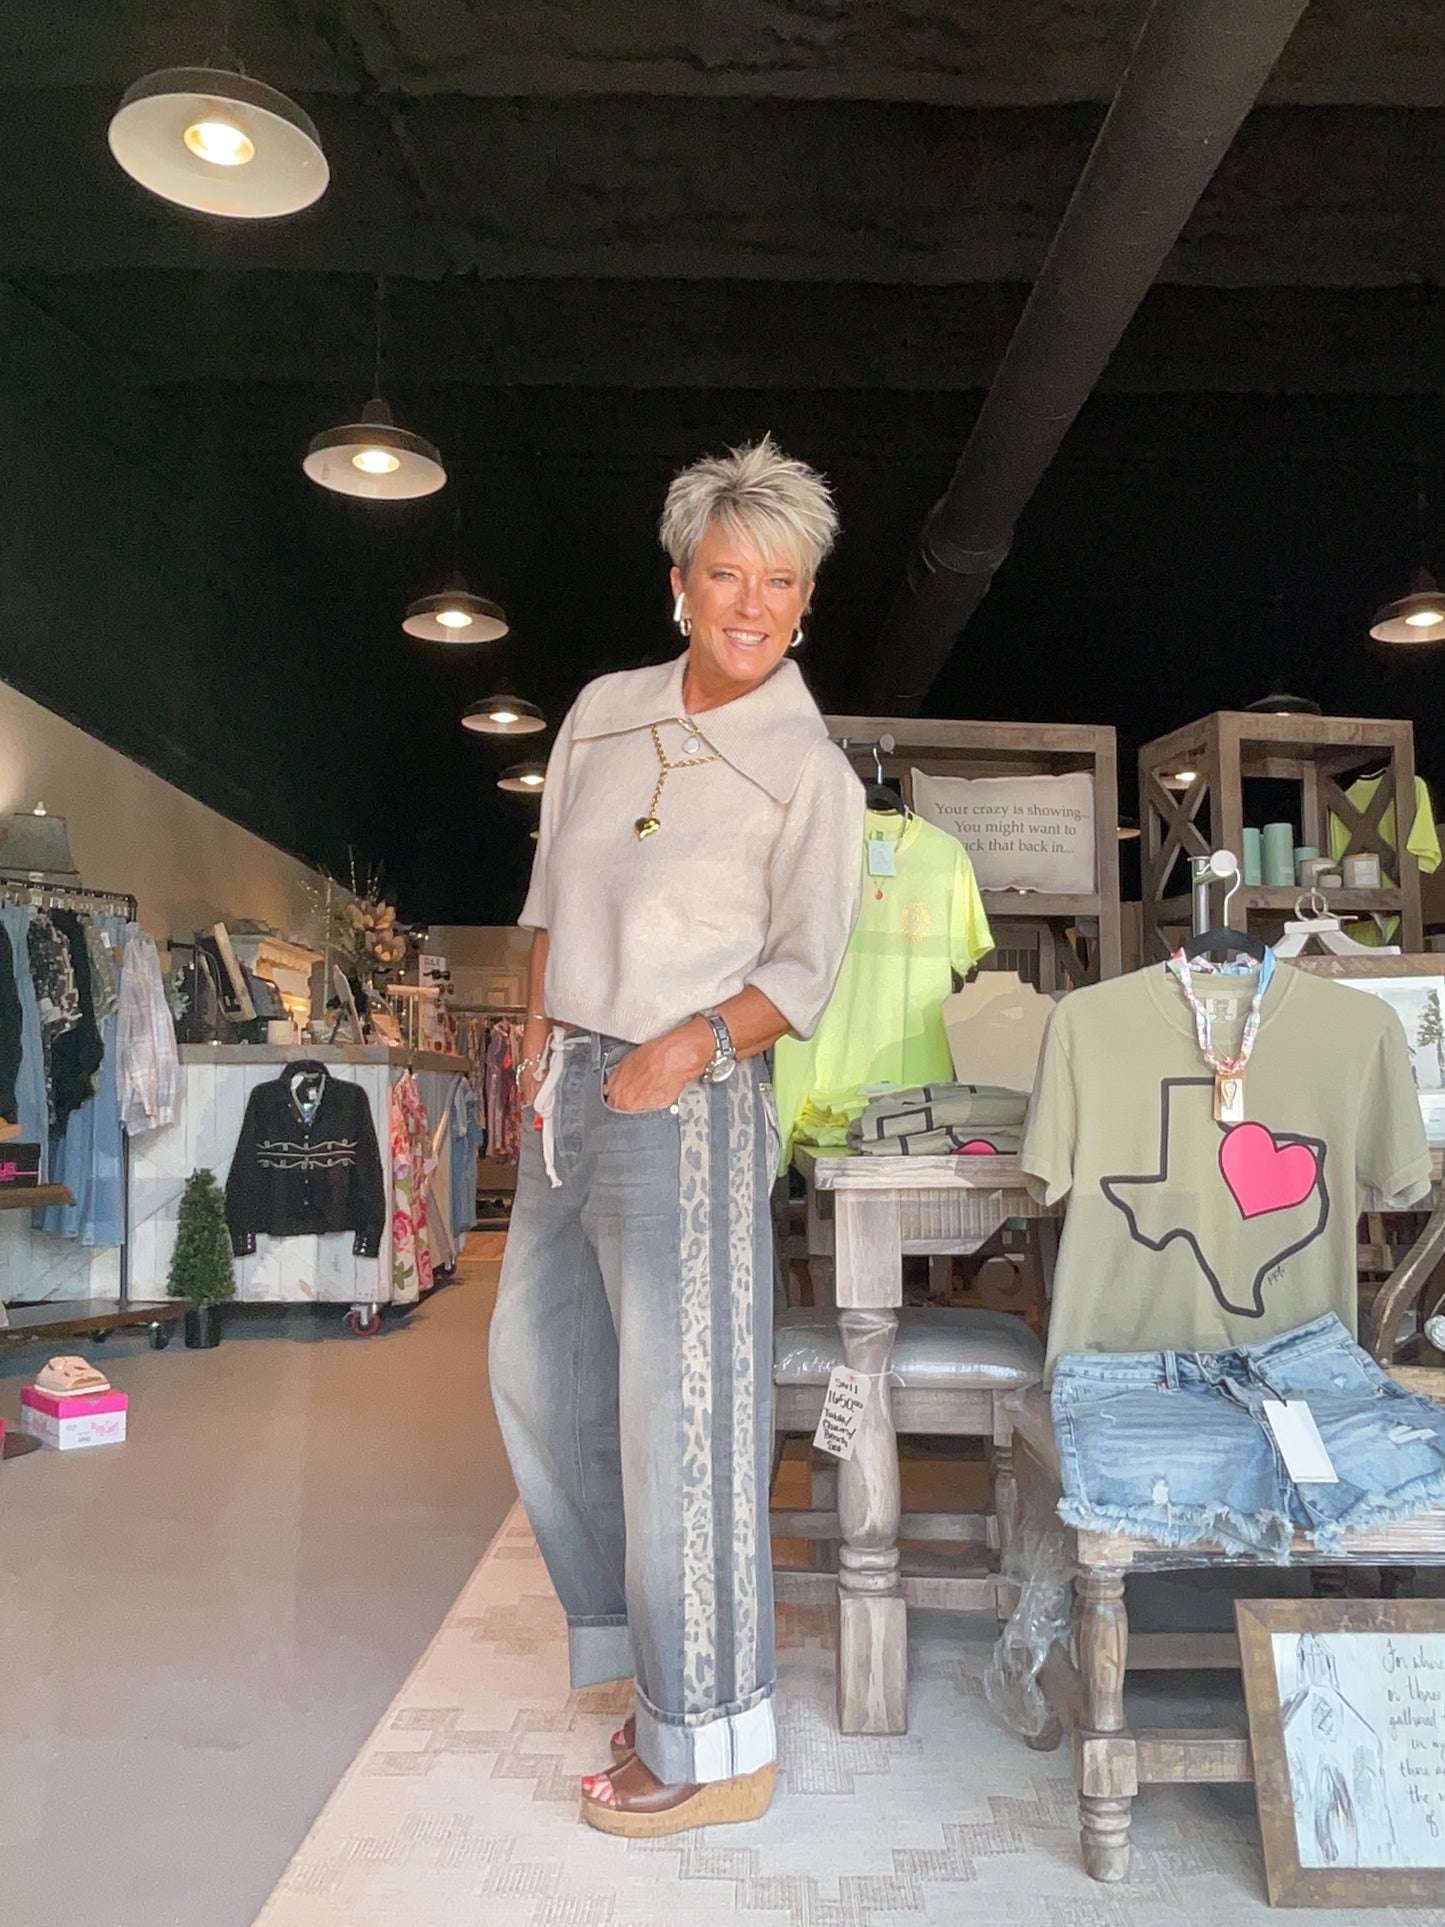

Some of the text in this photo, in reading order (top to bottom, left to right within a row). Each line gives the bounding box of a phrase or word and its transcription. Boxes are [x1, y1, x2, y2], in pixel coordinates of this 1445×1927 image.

[935, 802, 969, 815] Your
[972, 804, 1009, 819] crazy
[1013, 803, 1024, 815] is
[954, 820, 1077, 836] You might want to
[988, 838, 1014, 851] that
[1018, 839, 1049, 853] back
[1382, 1639, 1408, 1674] For
[1408, 1784, 1429, 1804] the
